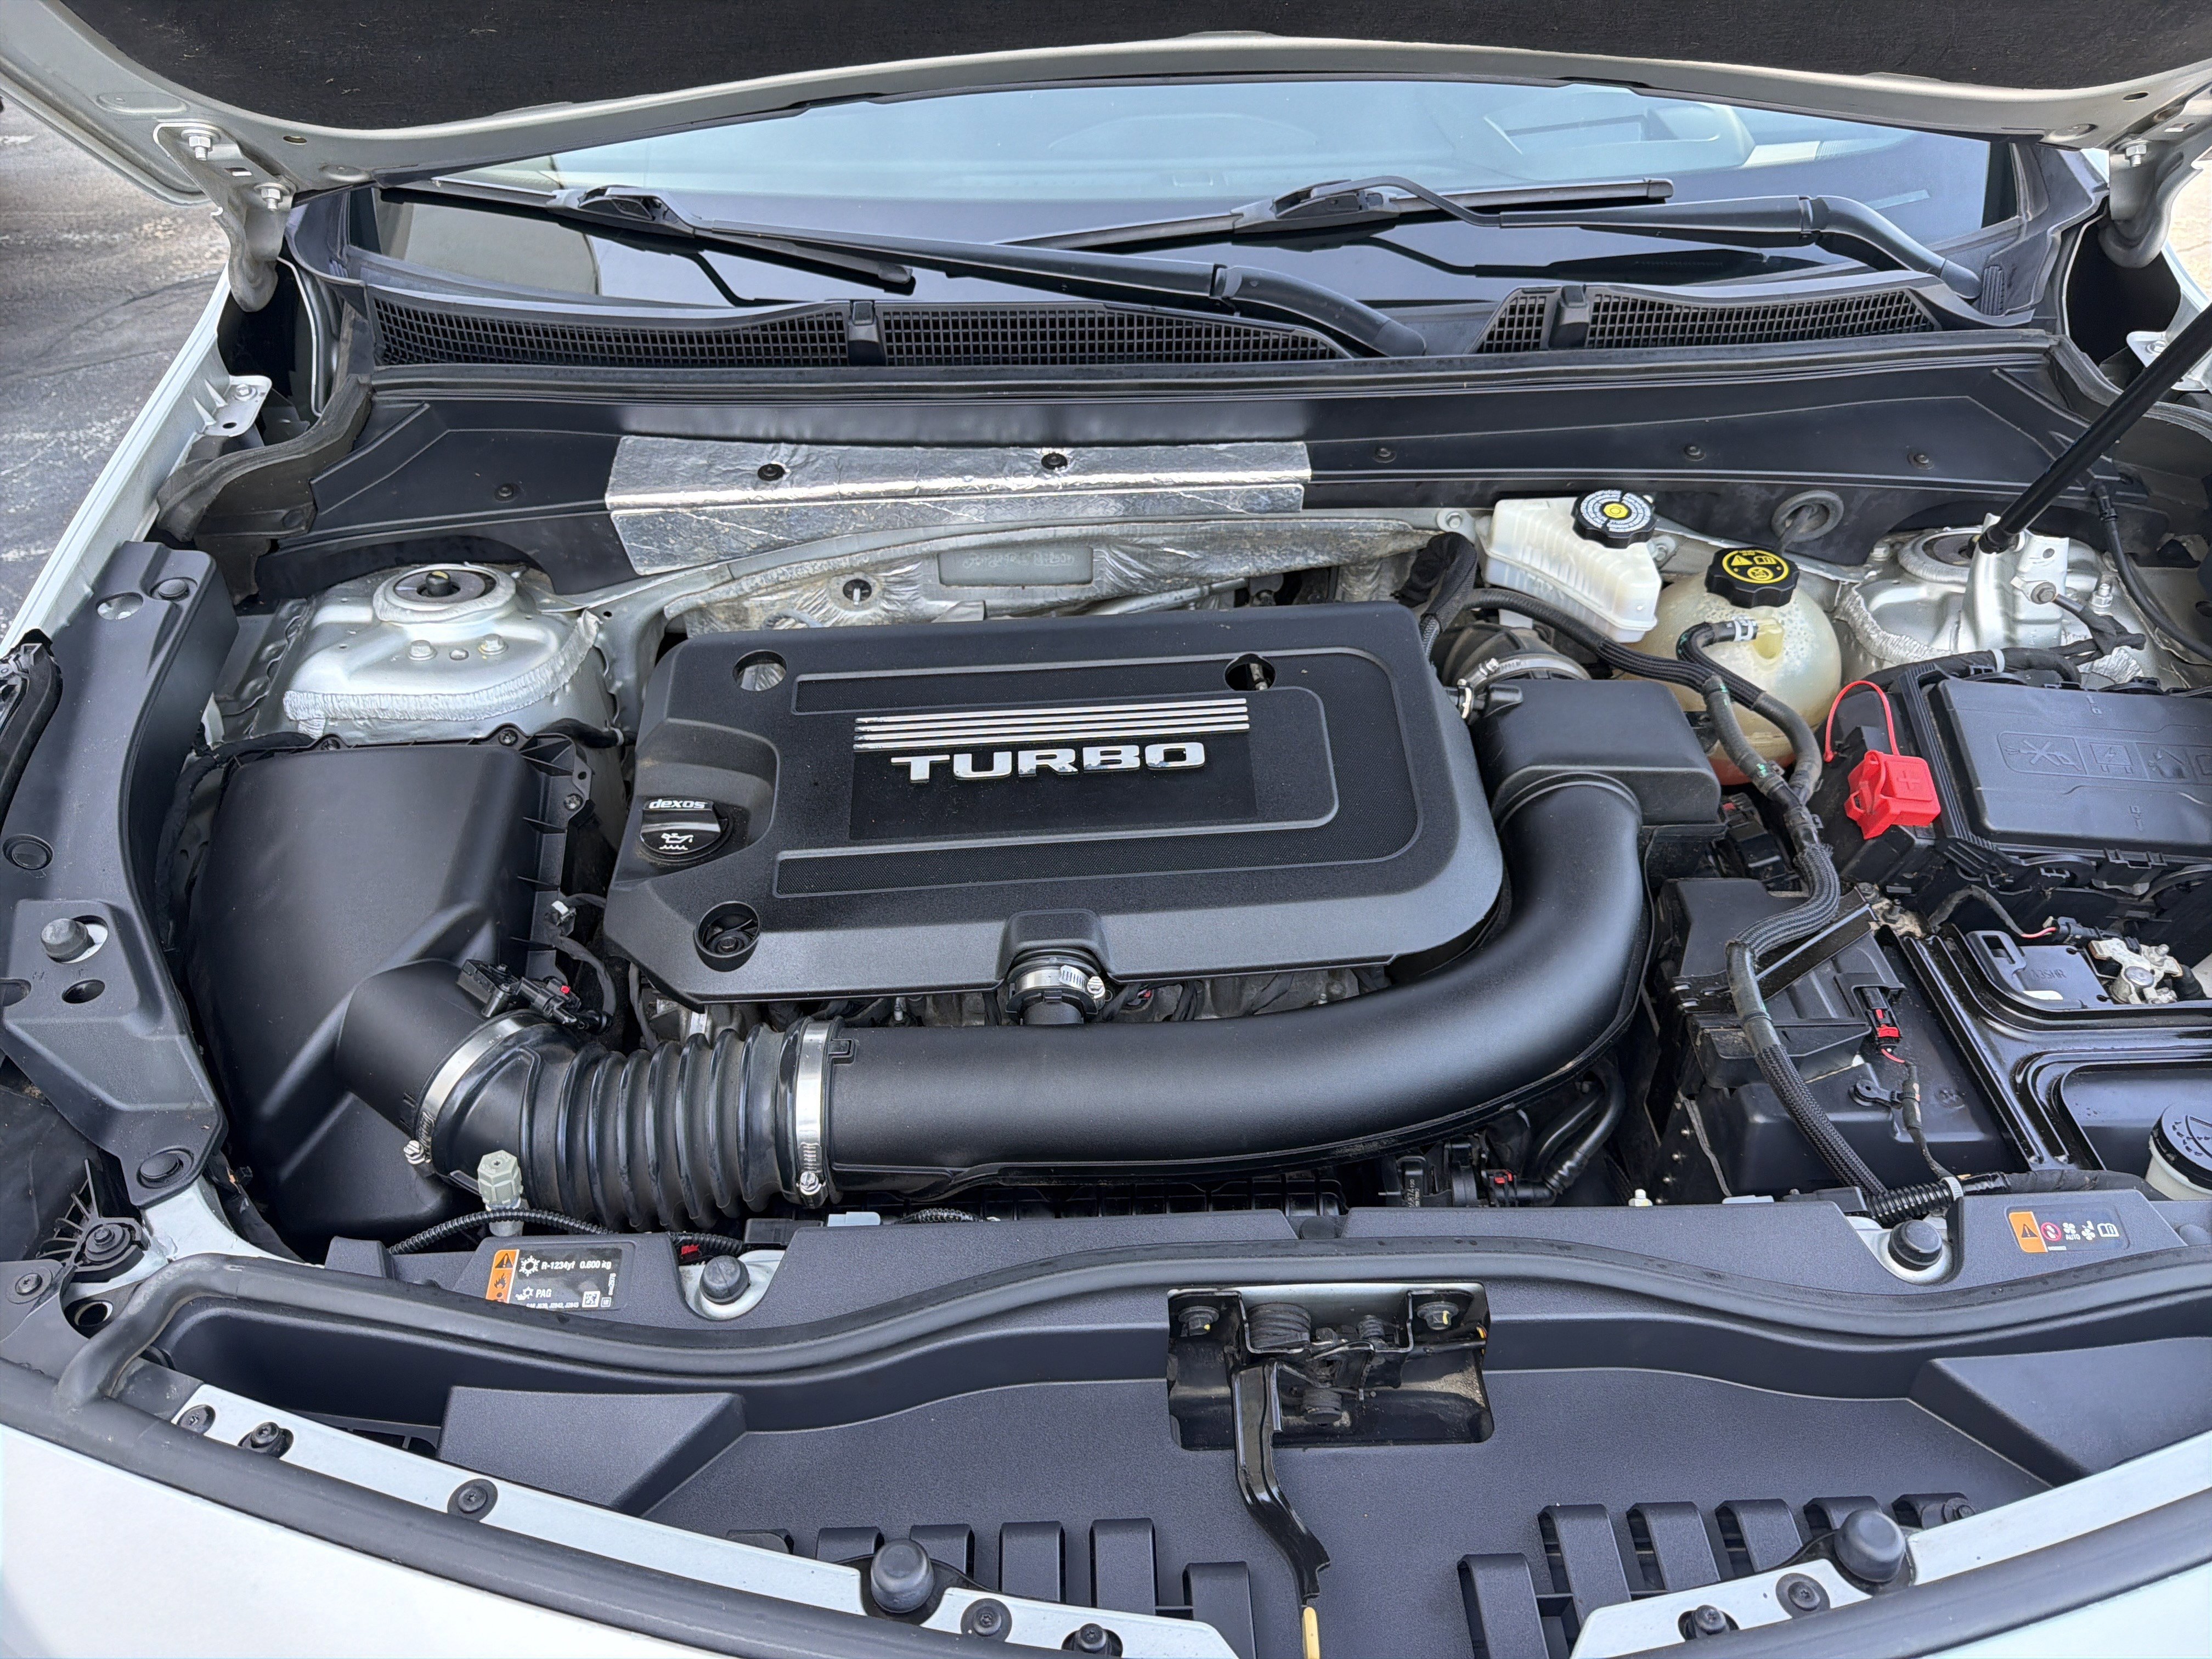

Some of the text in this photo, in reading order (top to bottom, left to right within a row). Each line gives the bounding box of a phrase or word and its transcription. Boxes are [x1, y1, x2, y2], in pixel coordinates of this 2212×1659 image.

[891, 742, 1206, 782] TURBO
[649, 799, 707, 809] dexos
[541, 1260, 612, 1271] R-1234yf 0.600 kg
[535, 1288, 552, 1298] PAG
